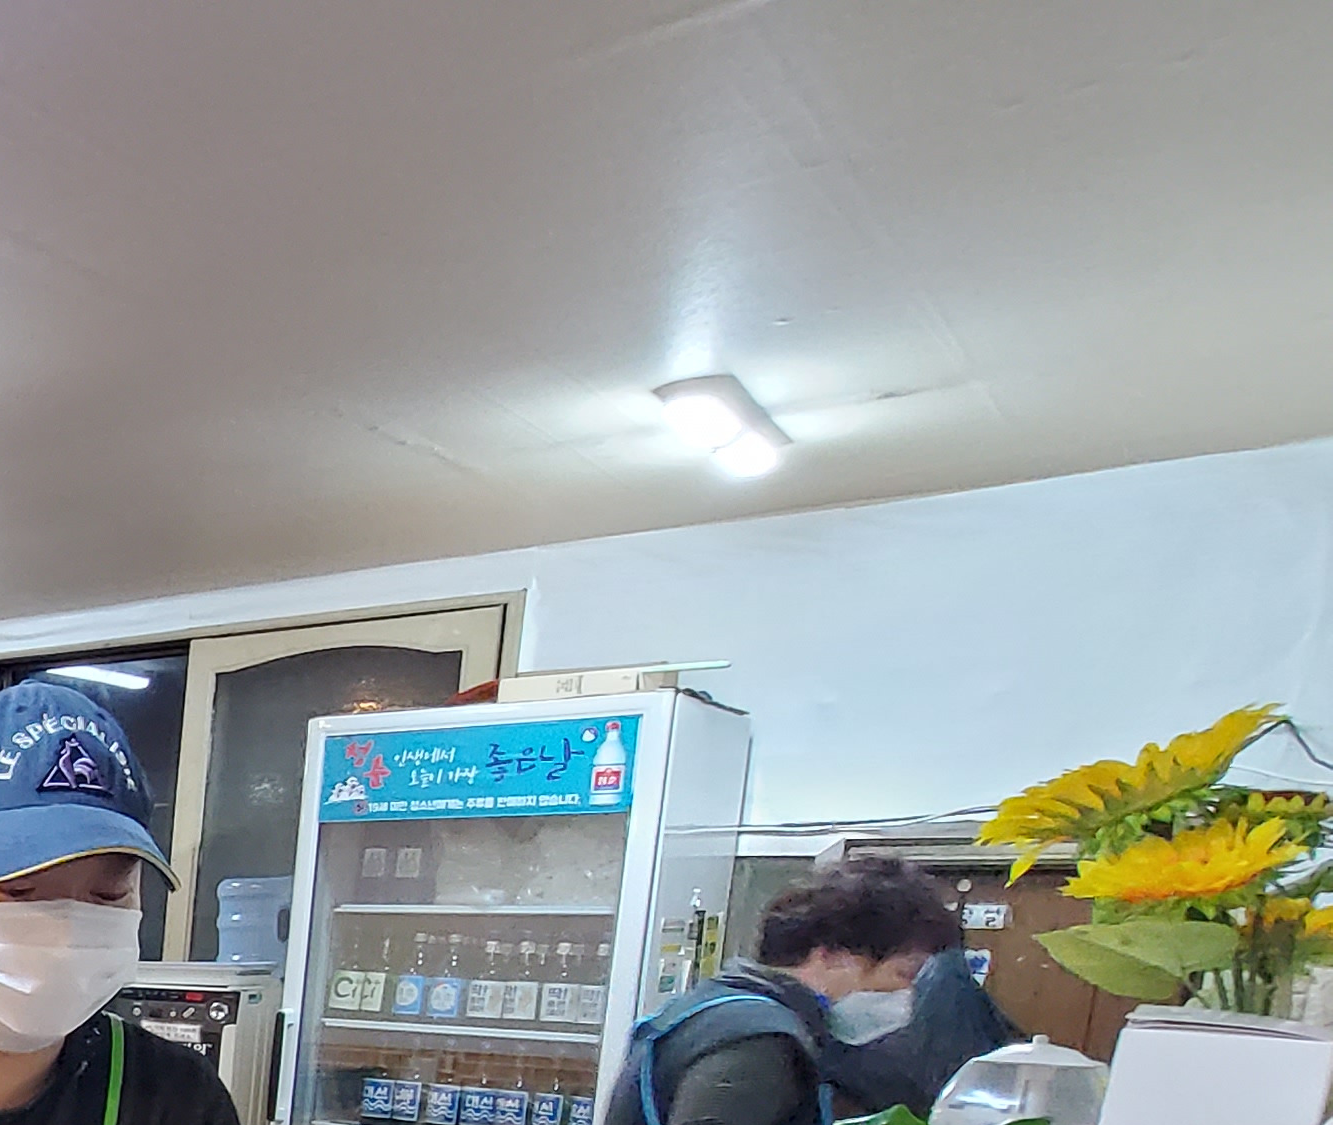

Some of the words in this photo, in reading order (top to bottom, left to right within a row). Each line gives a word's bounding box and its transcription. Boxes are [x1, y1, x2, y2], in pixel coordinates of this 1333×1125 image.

[393, 747, 456, 767] 인생에서
[408, 768, 443, 788] 오늘이
[448, 765, 479, 785] 가장
